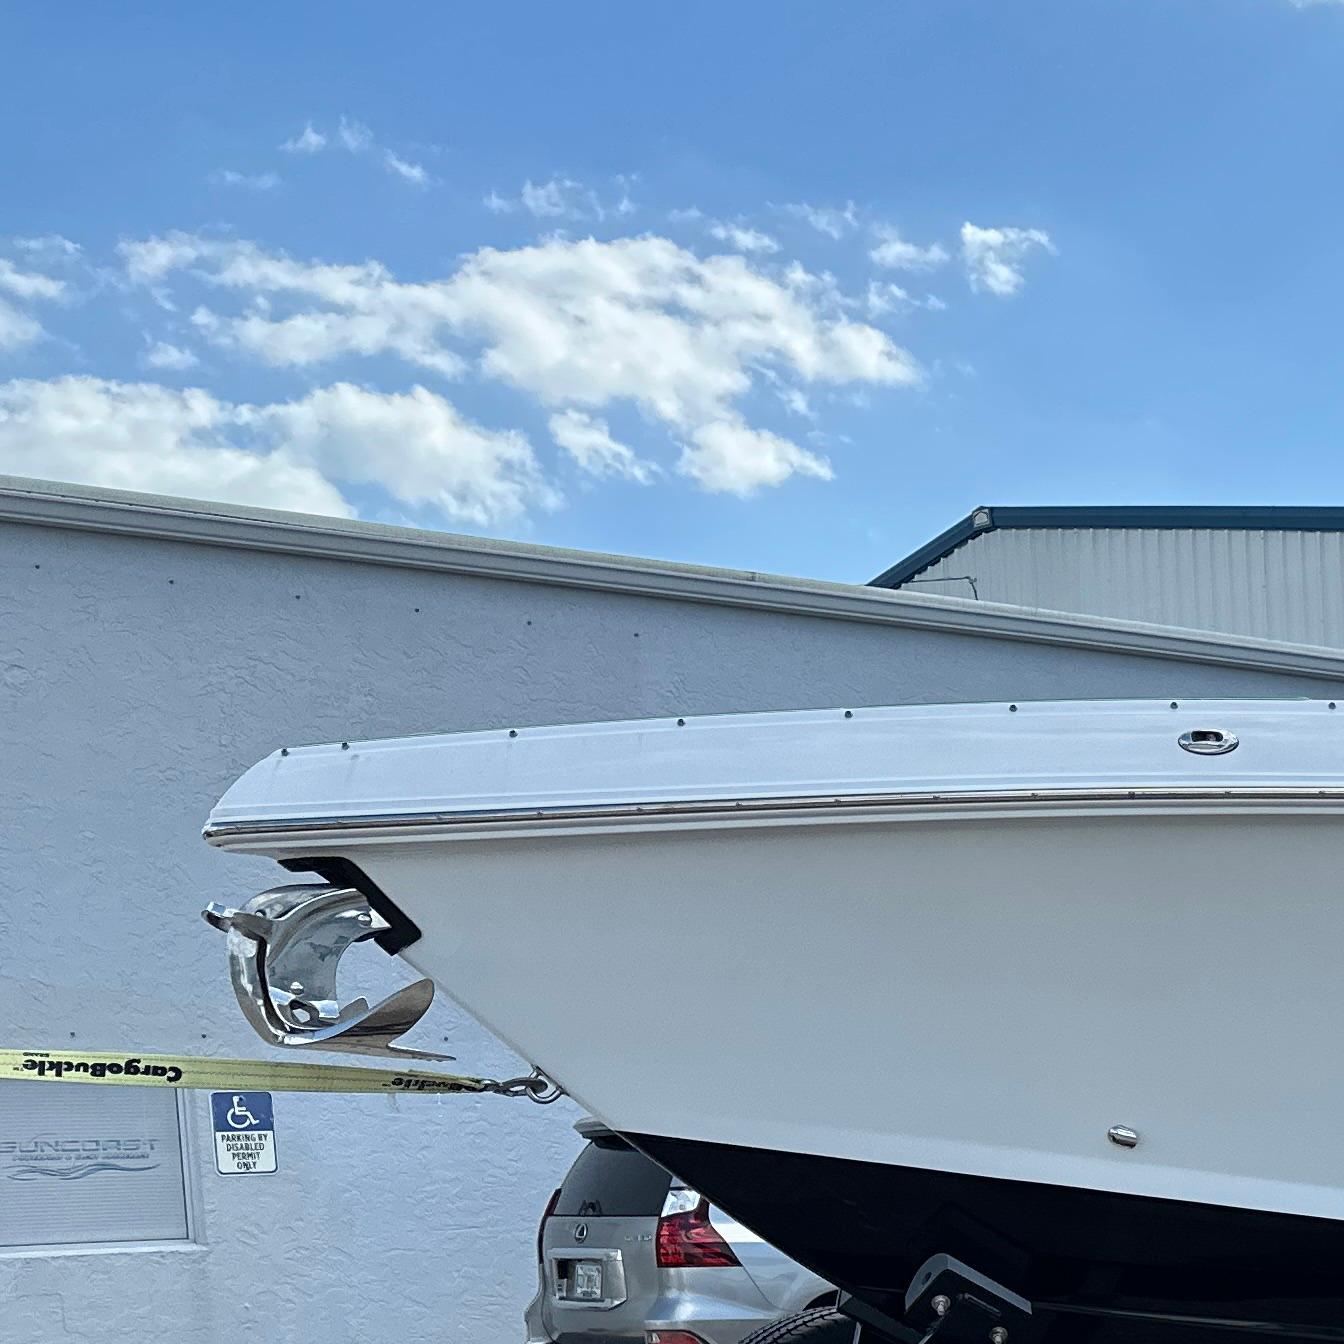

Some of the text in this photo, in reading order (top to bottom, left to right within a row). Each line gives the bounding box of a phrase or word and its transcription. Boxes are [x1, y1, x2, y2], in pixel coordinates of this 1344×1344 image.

[22, 1058, 183, 1083] CargoBuckle
[221, 1133, 268, 1143] PARKING BY
[226, 1142, 265, 1152] DISABLED
[232, 1152, 261, 1161] PERMIT
[237, 1161, 257, 1170] ONLY
